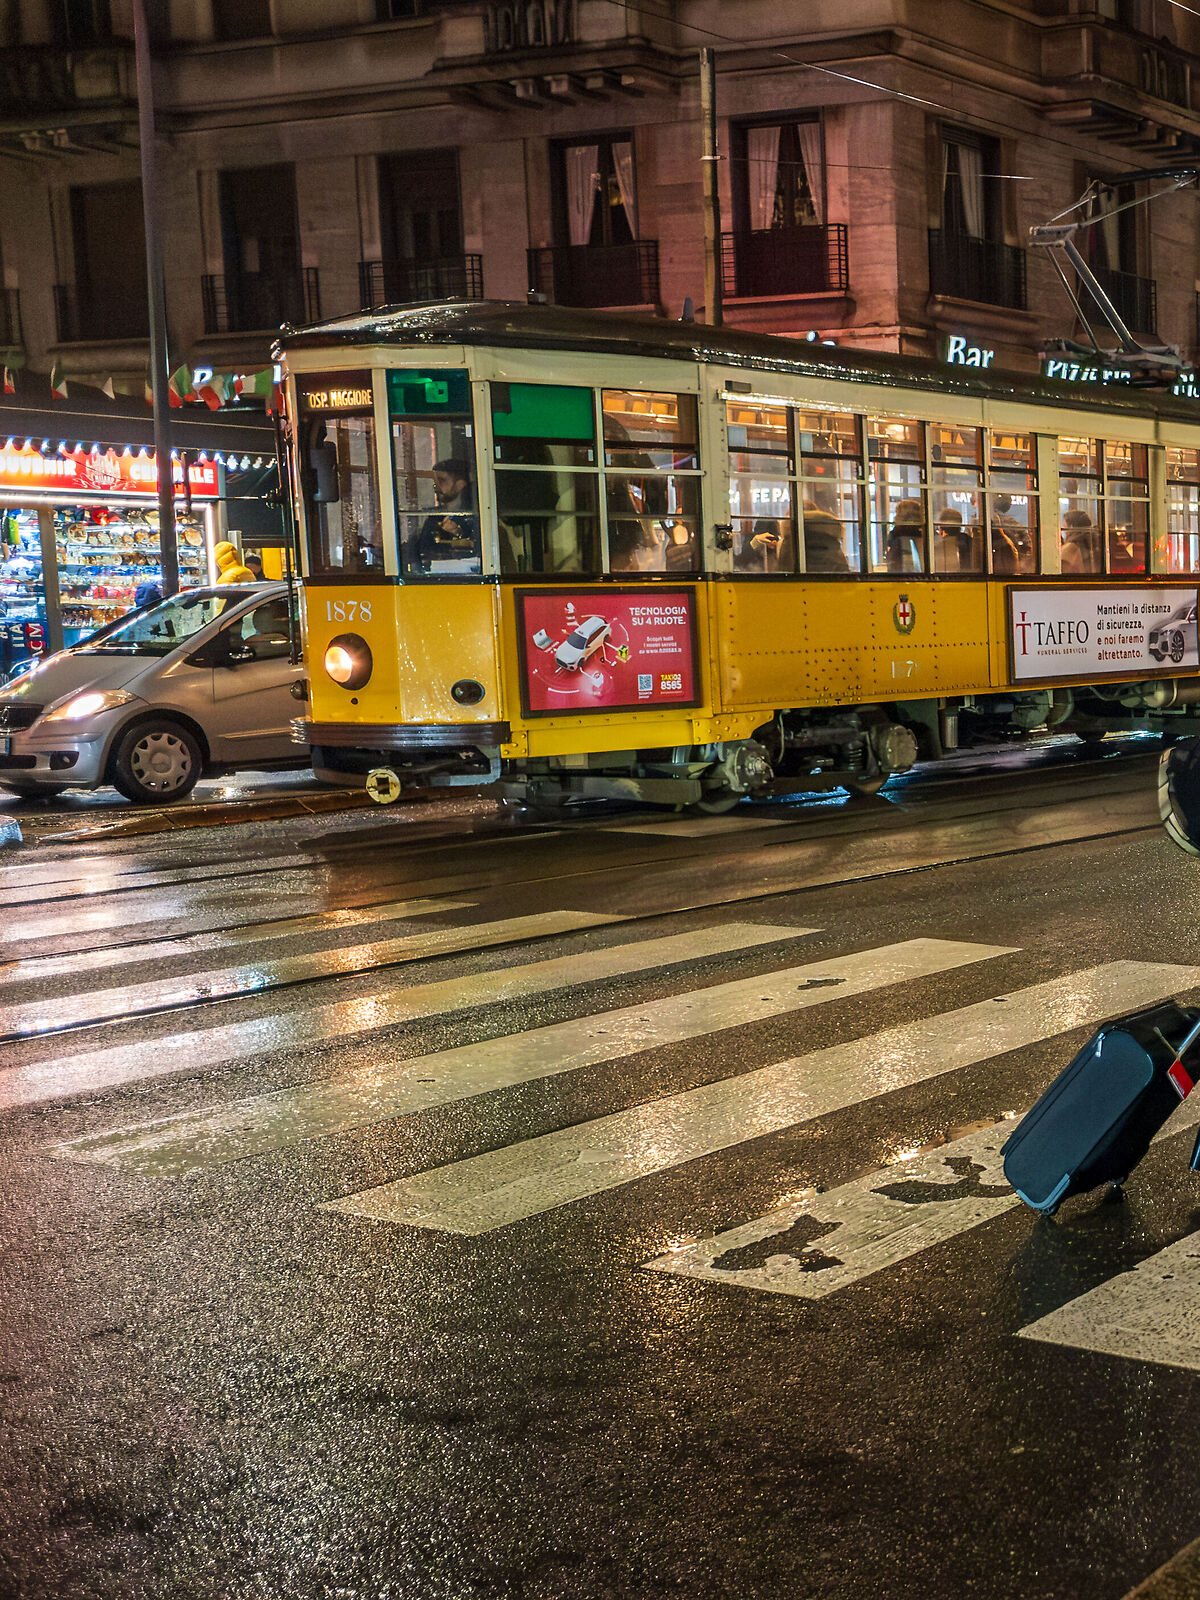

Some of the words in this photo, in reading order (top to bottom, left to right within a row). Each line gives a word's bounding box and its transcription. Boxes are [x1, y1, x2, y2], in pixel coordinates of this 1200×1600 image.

[946, 335, 994, 368] Bar
[330, 388, 373, 407] MAGGIORE
[326, 600, 372, 622] 1878
[629, 606, 687, 616] TECNOLOGIA
[1097, 604, 1130, 615] Mantieni
[1132, 603, 1139, 614] la
[1140, 603, 1171, 614] distanza
[632, 617, 644, 626] SU
[646, 617, 652, 625] 4
[654, 616, 686, 625] RUOTE.
[1097, 619, 1105, 630] di
[1106, 619, 1145, 630] sicurezza,
[1034, 619, 1090, 645] TAFFO
[1104, 634, 1116, 645] noi
[1118, 634, 1144, 645] faremo
[1097, 649, 1143, 661] altrettanto.
[660, 681, 682, 690] 8585
